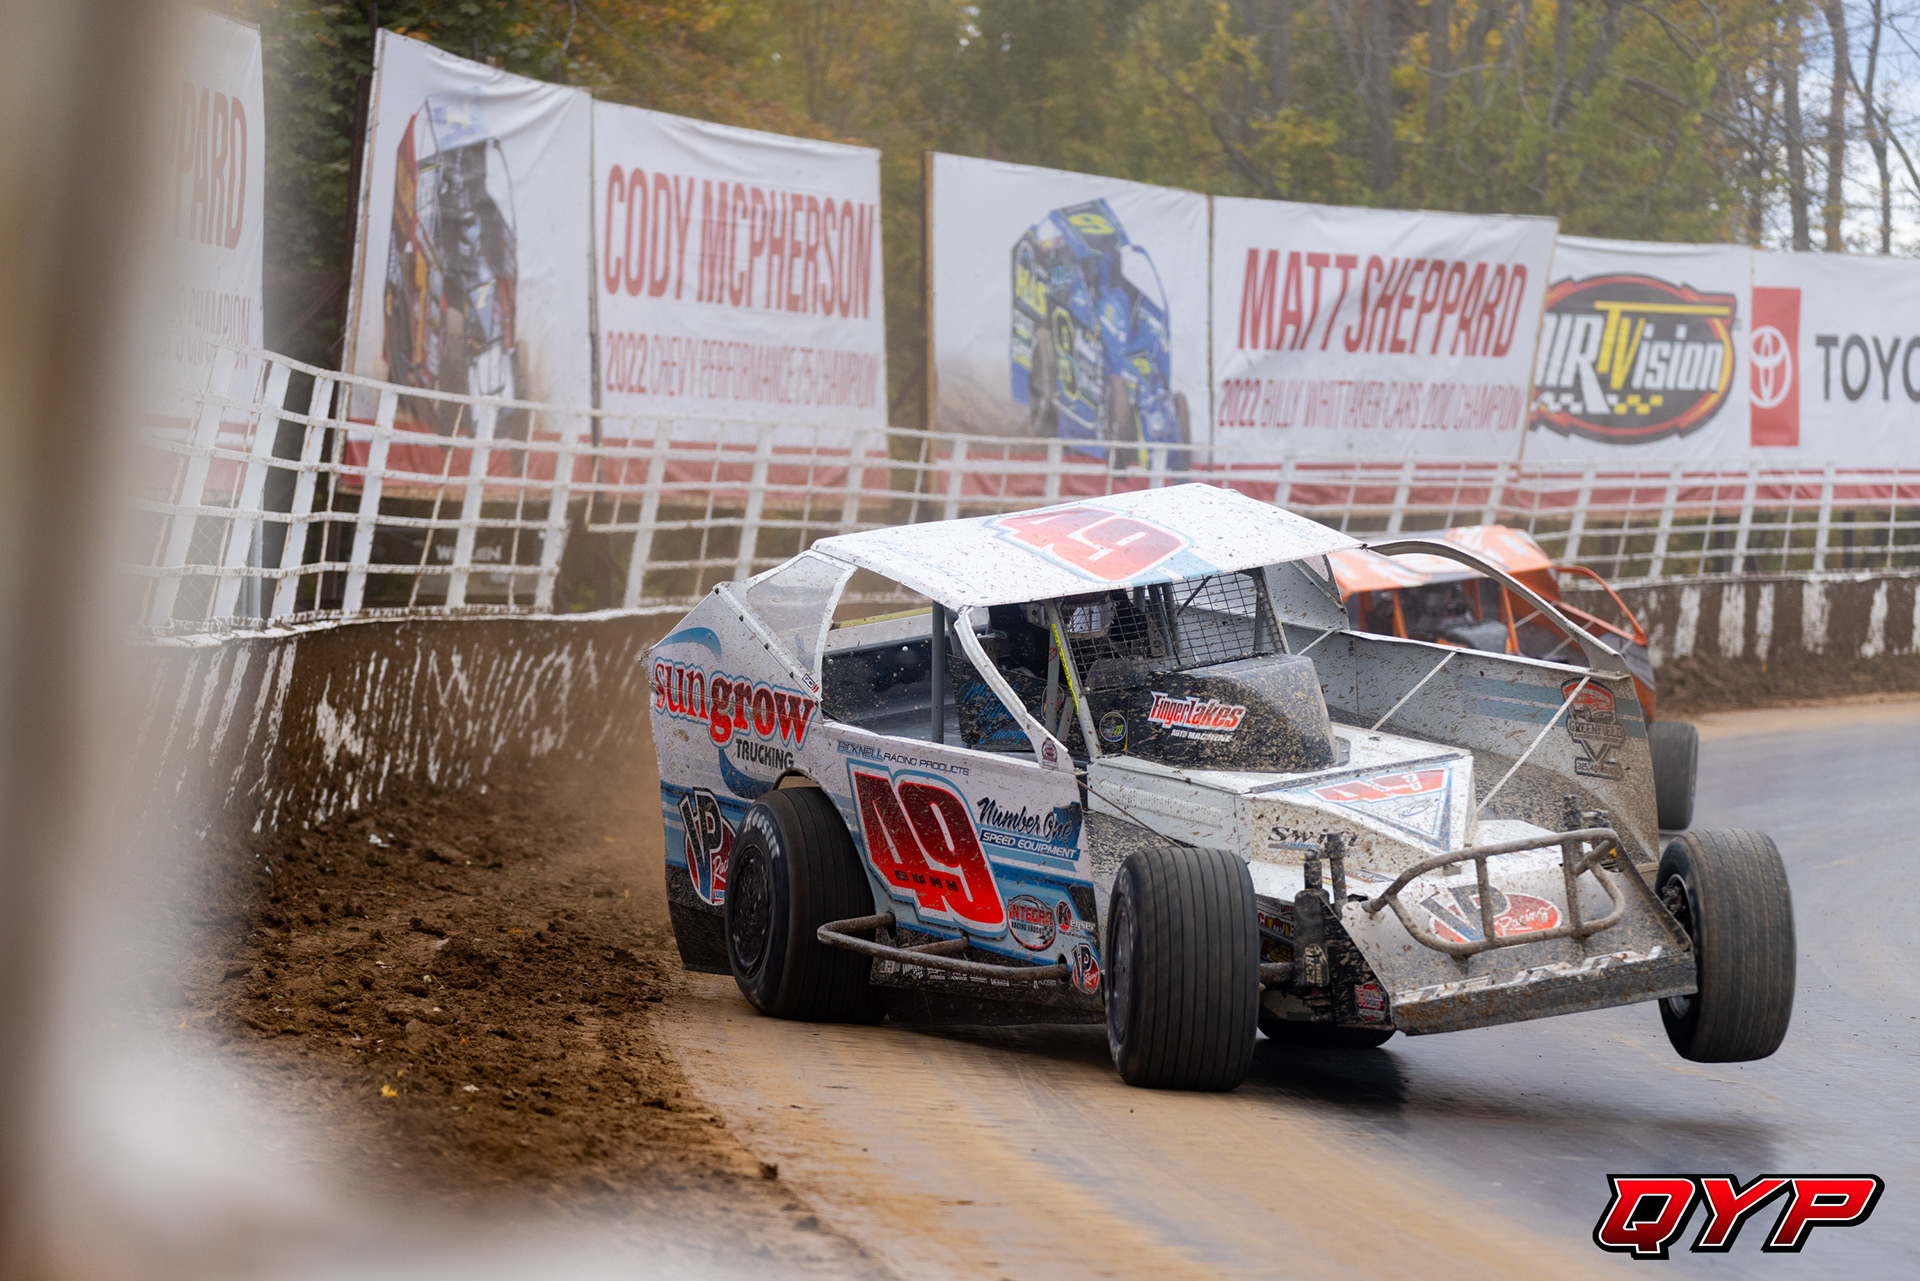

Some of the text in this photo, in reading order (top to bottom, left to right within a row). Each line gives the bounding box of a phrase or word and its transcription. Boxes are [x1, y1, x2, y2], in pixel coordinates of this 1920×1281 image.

[604, 164, 874, 319] CODY MCPHERSON
[1238, 247, 1528, 358] MATT SHEPPARD
[606, 330, 648, 394] 2022
[1218, 377, 1262, 428] 2022
[997, 506, 1183, 582] 49
[654, 663, 816, 744] sungrow
[735, 738, 795, 771] TRUCKING
[837, 740, 970, 776] BICKNELL RACING PRODUCTS
[1311, 768, 1446, 801] 49
[976, 796, 1041, 836] Number
[853, 771, 1005, 925] 49
[981, 831, 1077, 859] SPEED EQUIPMENT
[893, 869, 960, 892] DUNN
